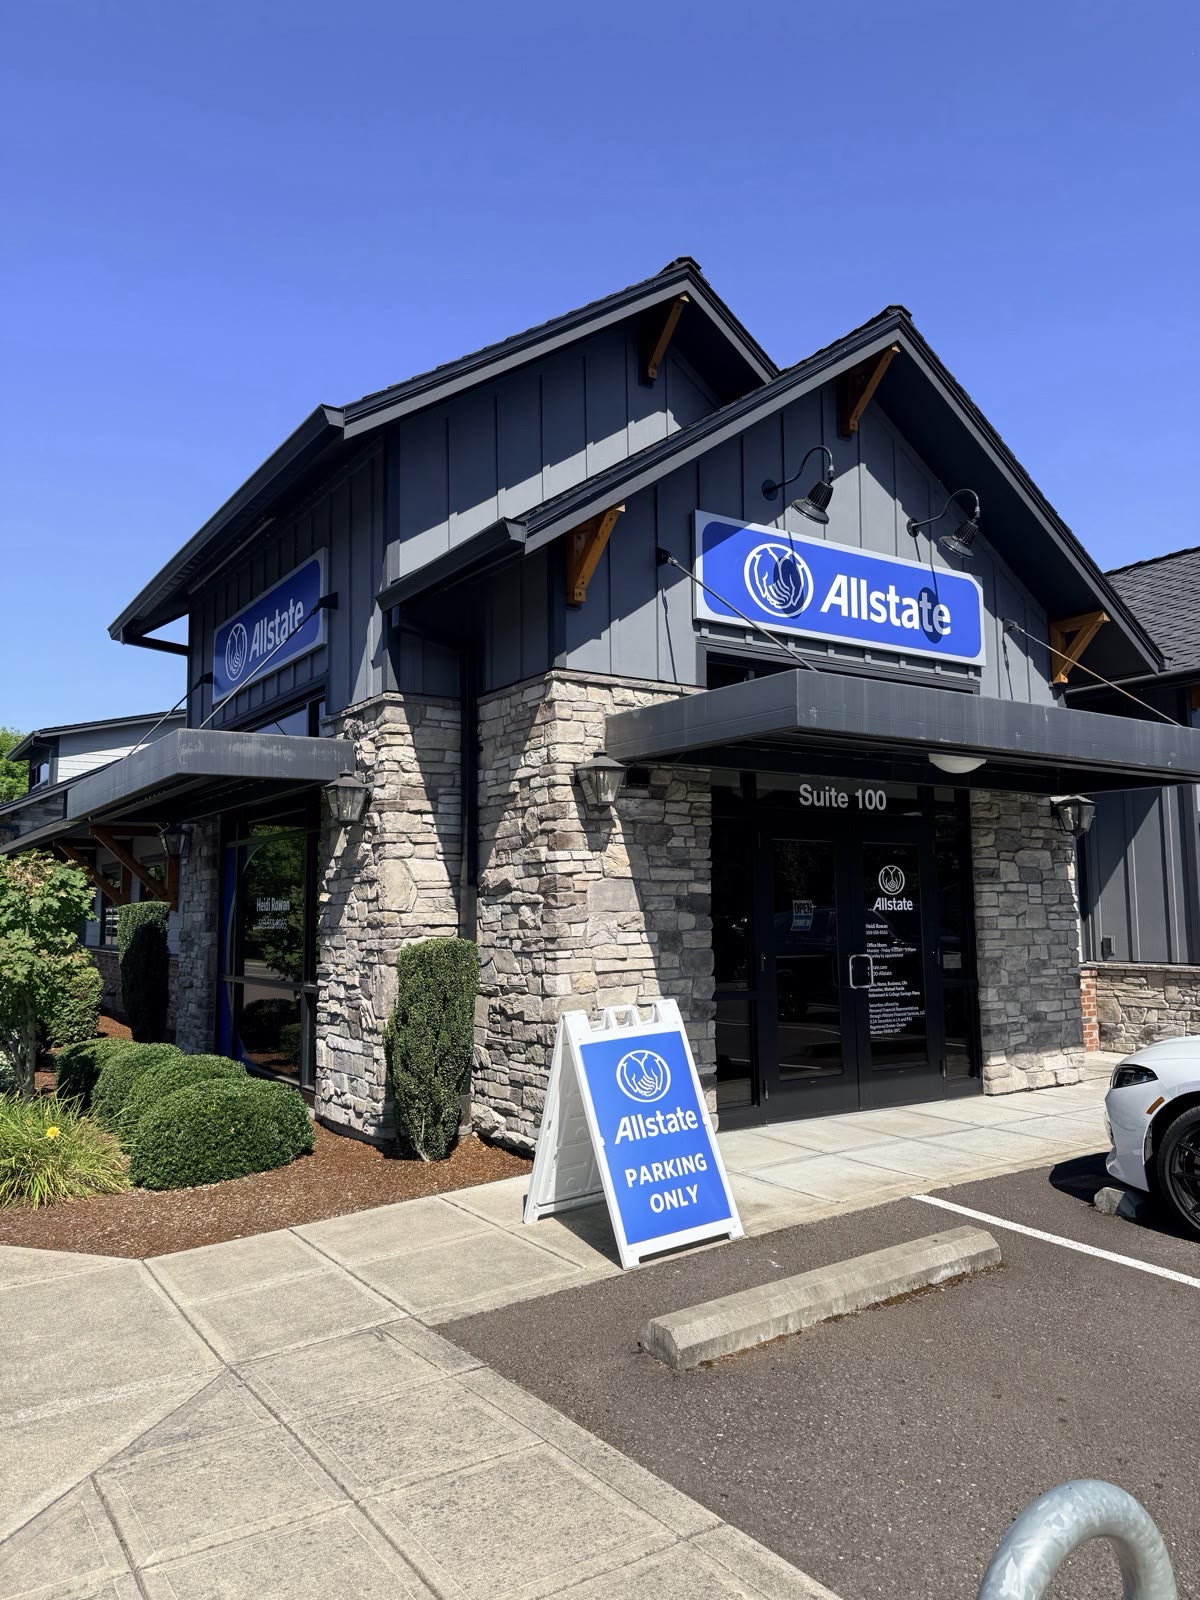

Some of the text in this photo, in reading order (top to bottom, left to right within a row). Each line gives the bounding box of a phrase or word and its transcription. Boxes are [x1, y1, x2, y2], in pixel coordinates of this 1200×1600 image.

[820, 574, 951, 636] Allstate
[249, 598, 304, 662] Allstate
[799, 784, 886, 810] Suite 100
[256, 897, 290, 911] Heidi Rowan
[794, 902, 812, 914] OPEN
[873, 898, 913, 910] Allstate
[615, 1106, 698, 1145] Allstate
[624, 1153, 708, 1188] PARKING
[650, 1184, 698, 1213] ONLY
